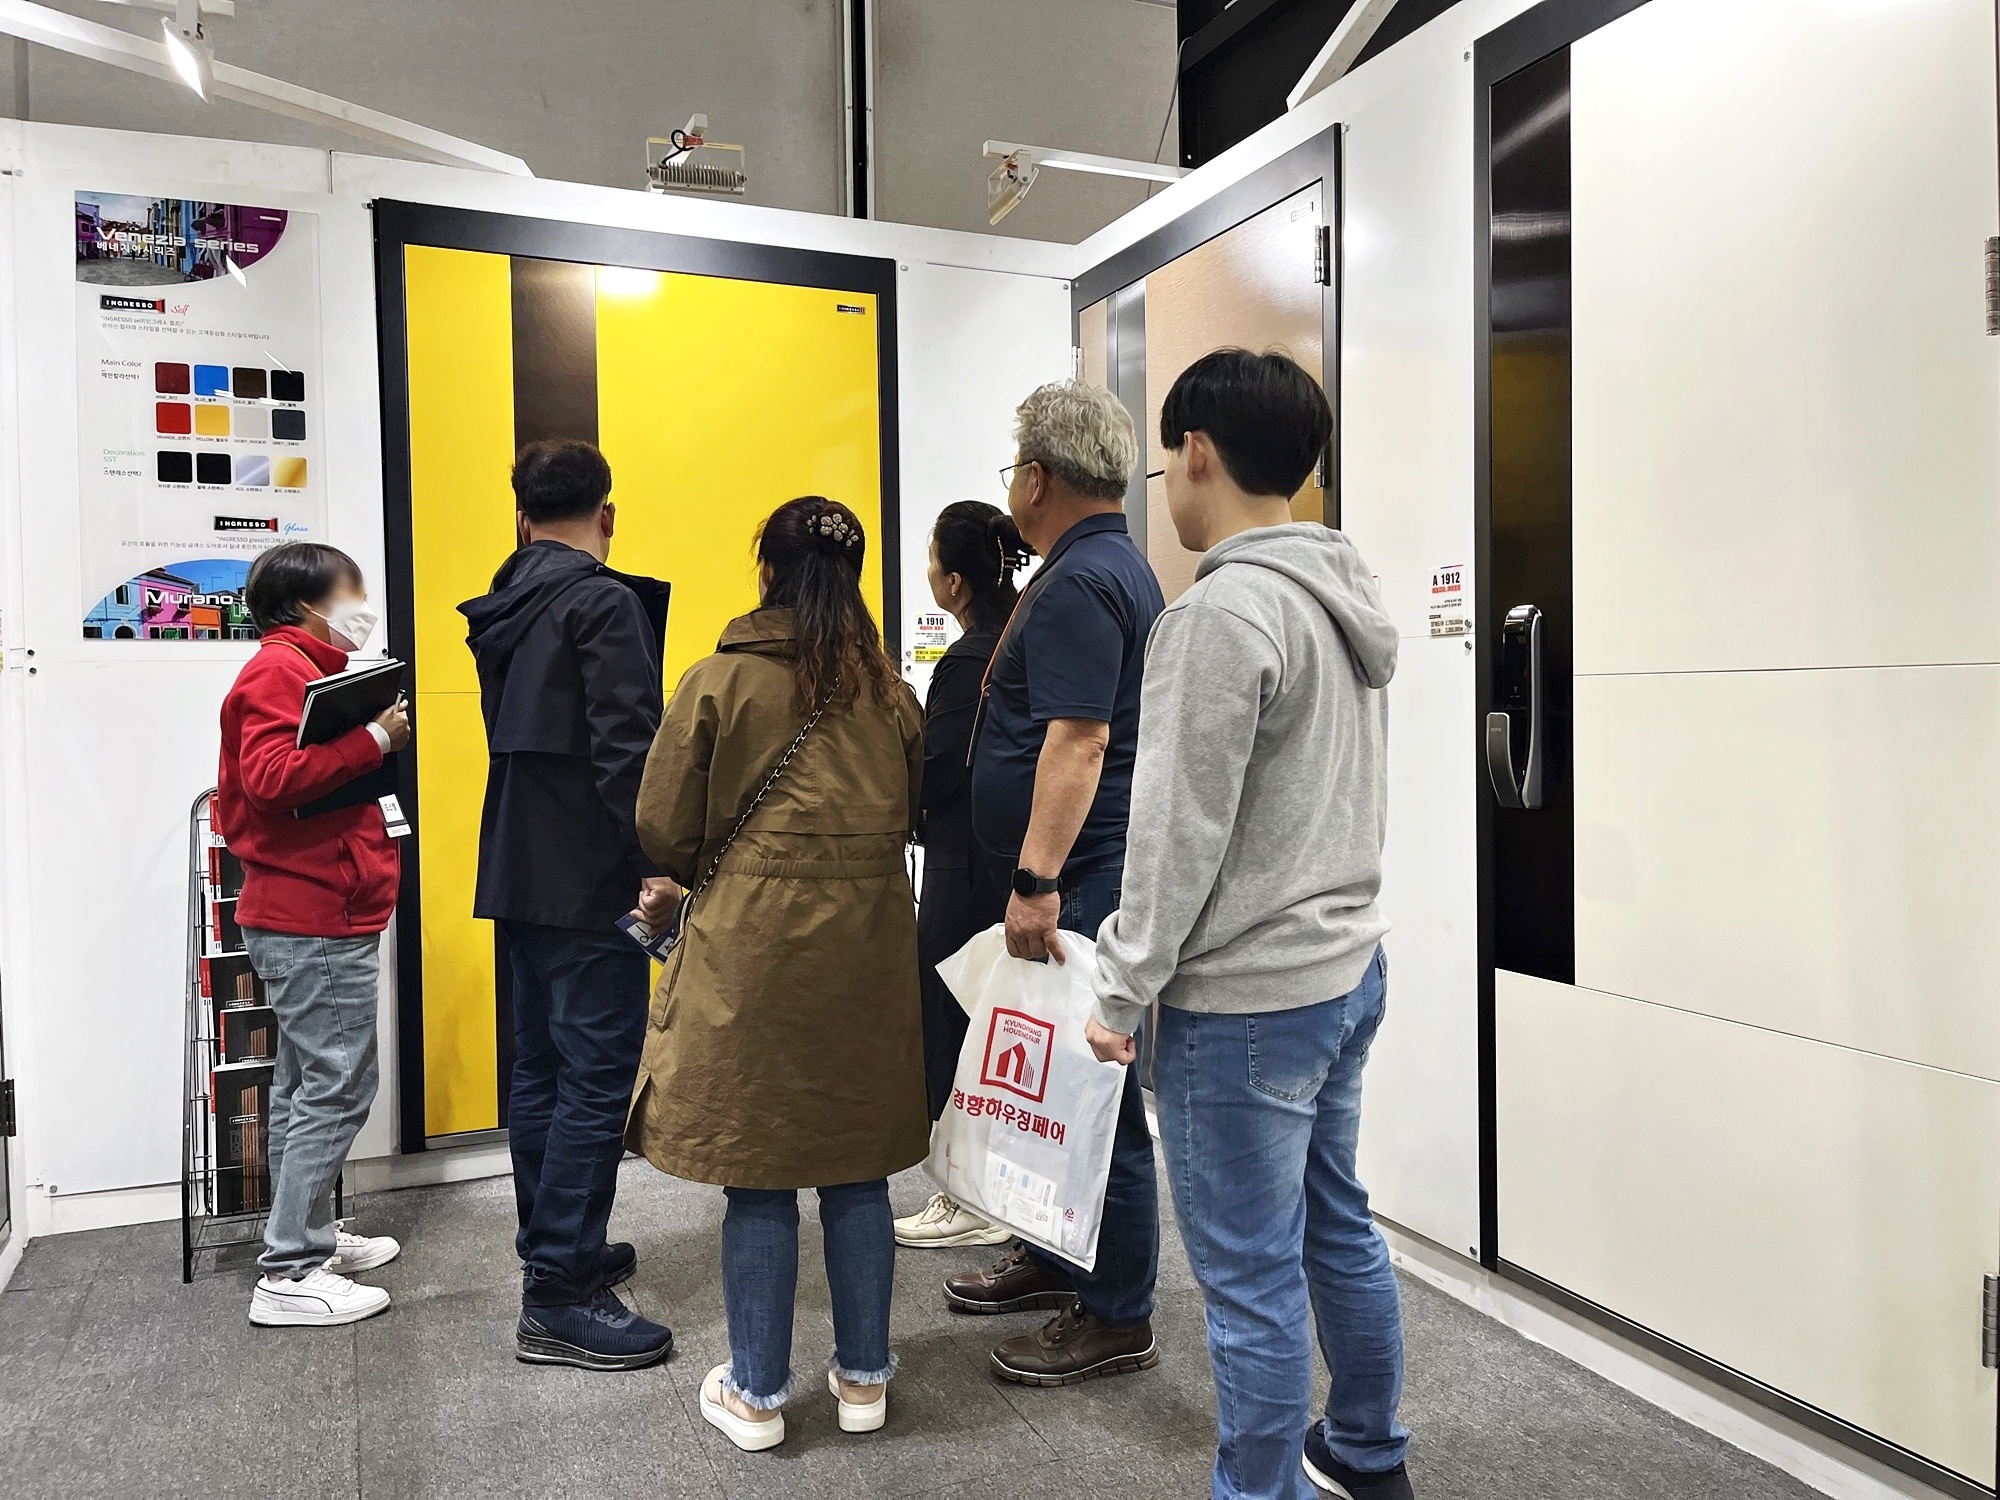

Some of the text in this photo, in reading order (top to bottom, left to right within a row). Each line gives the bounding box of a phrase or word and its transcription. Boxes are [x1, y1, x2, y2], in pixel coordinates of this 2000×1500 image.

[96, 227, 259, 253] Venezia series
[97, 242, 175, 256] 베네치아시리즈
[106, 300, 190, 316] INGRESSO Self
[101, 358, 121, 366] Main
[103, 448, 146, 456] Decoration
[219, 520, 308, 535] INGRESSO Glass
[1432, 572, 1460, 586] A 1912
[145, 591, 233, 605] Murano
[917, 617, 944, 626] A 1910
[1004, 1019, 1042, 1038] KYUNGHYANG
[953, 1087, 1066, 1145] 경향하우징페어
